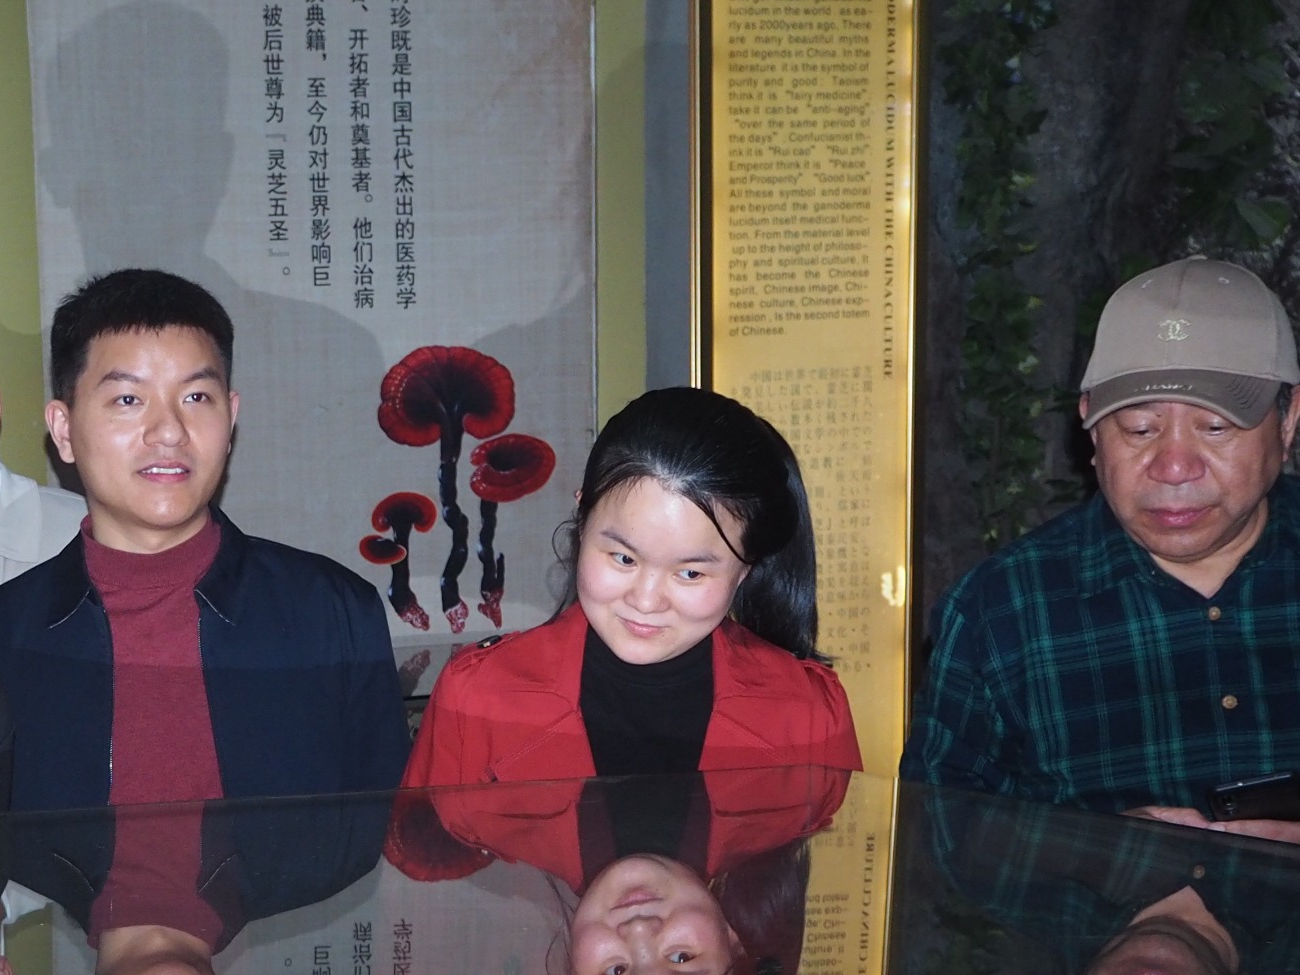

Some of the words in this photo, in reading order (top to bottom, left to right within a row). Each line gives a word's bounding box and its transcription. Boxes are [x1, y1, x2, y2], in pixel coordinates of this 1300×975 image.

[886, 0, 897, 66] DERMA
[305, 0, 332, 288] 典籍，至今仍对世界影响巨
[886, 70, 896, 151] LUCIDUM
[348, 0, 375, 310] 、开拓者和奠基者。他们治病
[390, 0, 417, 310] 珍既是中国古代杰出的医药学
[885, 156, 895, 203] WITH
[885, 208, 895, 240] THE
[884, 244, 894, 298] CHINA
[883, 301, 894, 380] CULTURE
